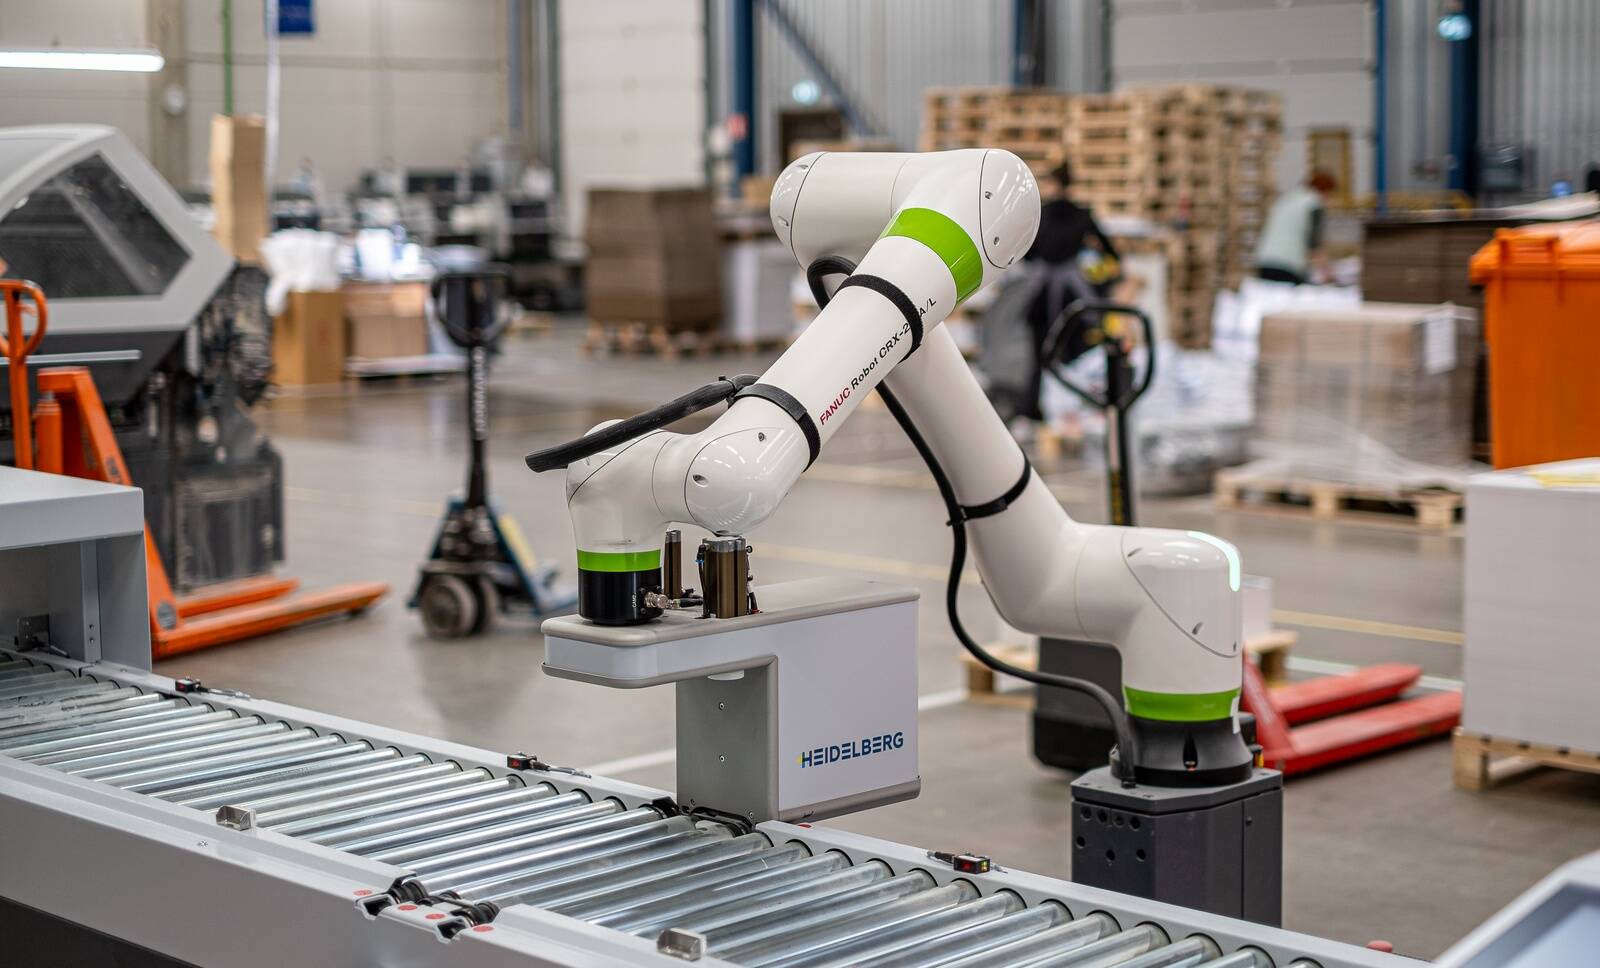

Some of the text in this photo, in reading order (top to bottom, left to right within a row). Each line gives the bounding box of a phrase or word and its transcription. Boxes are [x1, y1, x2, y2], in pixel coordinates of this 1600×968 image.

[818, 297, 937, 426] FANUC Robot CRX-2A/L
[801, 731, 904, 769] HEIDELBERG
